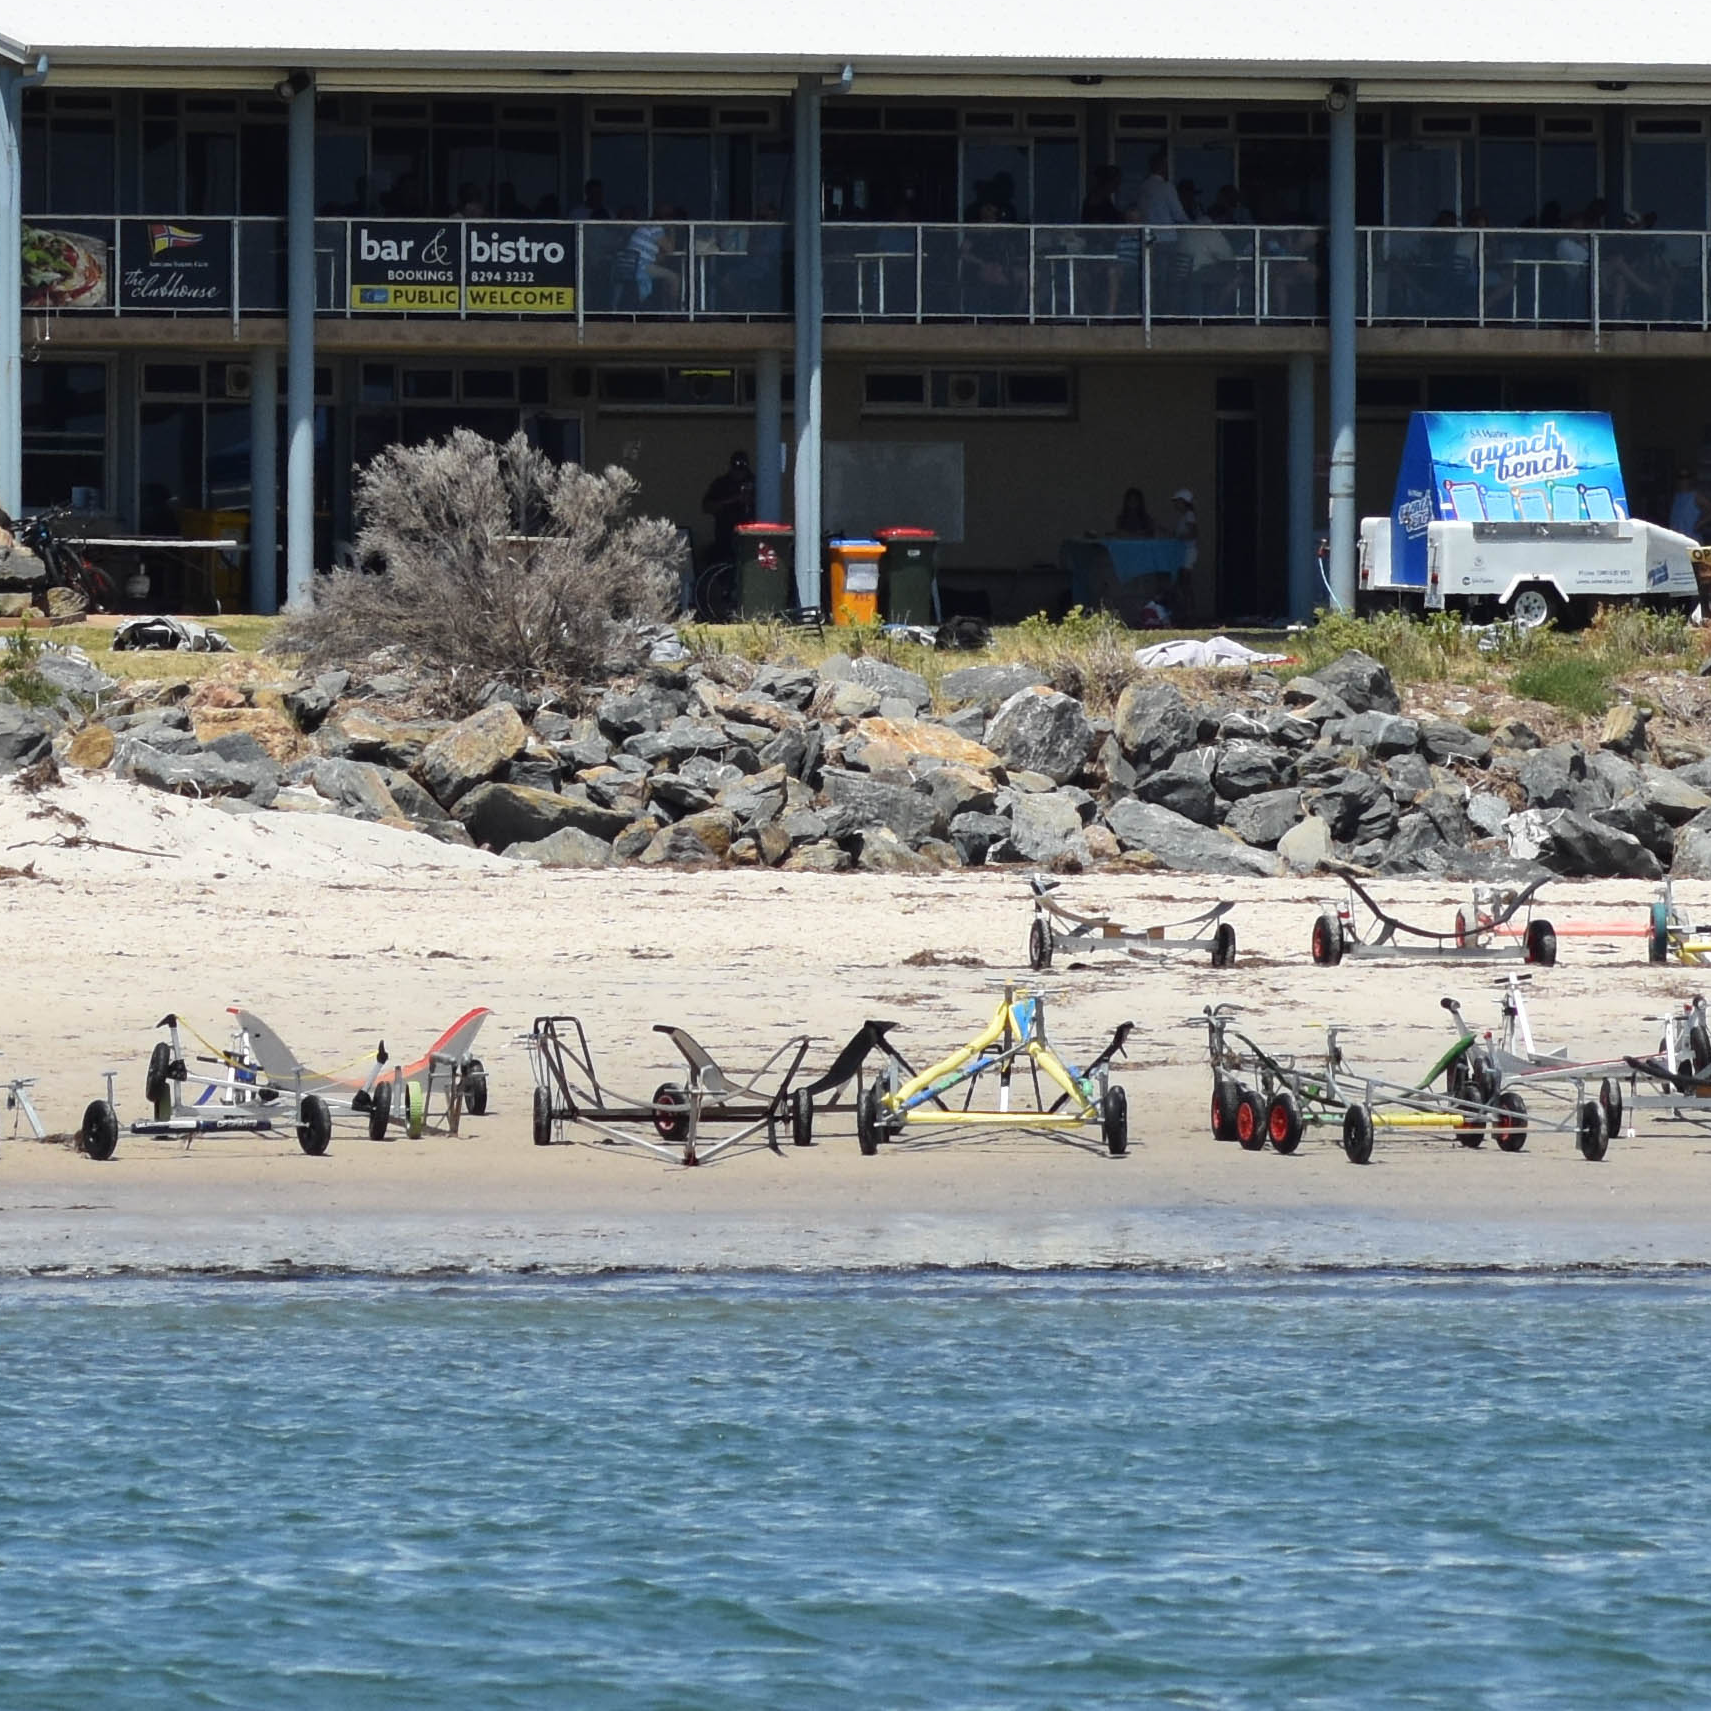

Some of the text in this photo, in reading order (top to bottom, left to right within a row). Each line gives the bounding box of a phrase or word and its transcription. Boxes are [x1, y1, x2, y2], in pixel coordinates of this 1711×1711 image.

[361, 228, 565, 265] bar & bistro
[131, 272, 218, 298] clubhouse
[388, 270, 535, 282] BOOKINGS 8294 3232
[393, 289, 456, 304] PUBLIC
[469, 290, 565, 305] WELCOME
[1469, 423, 1562, 471] quench
[1496, 443, 1575, 482] bench
